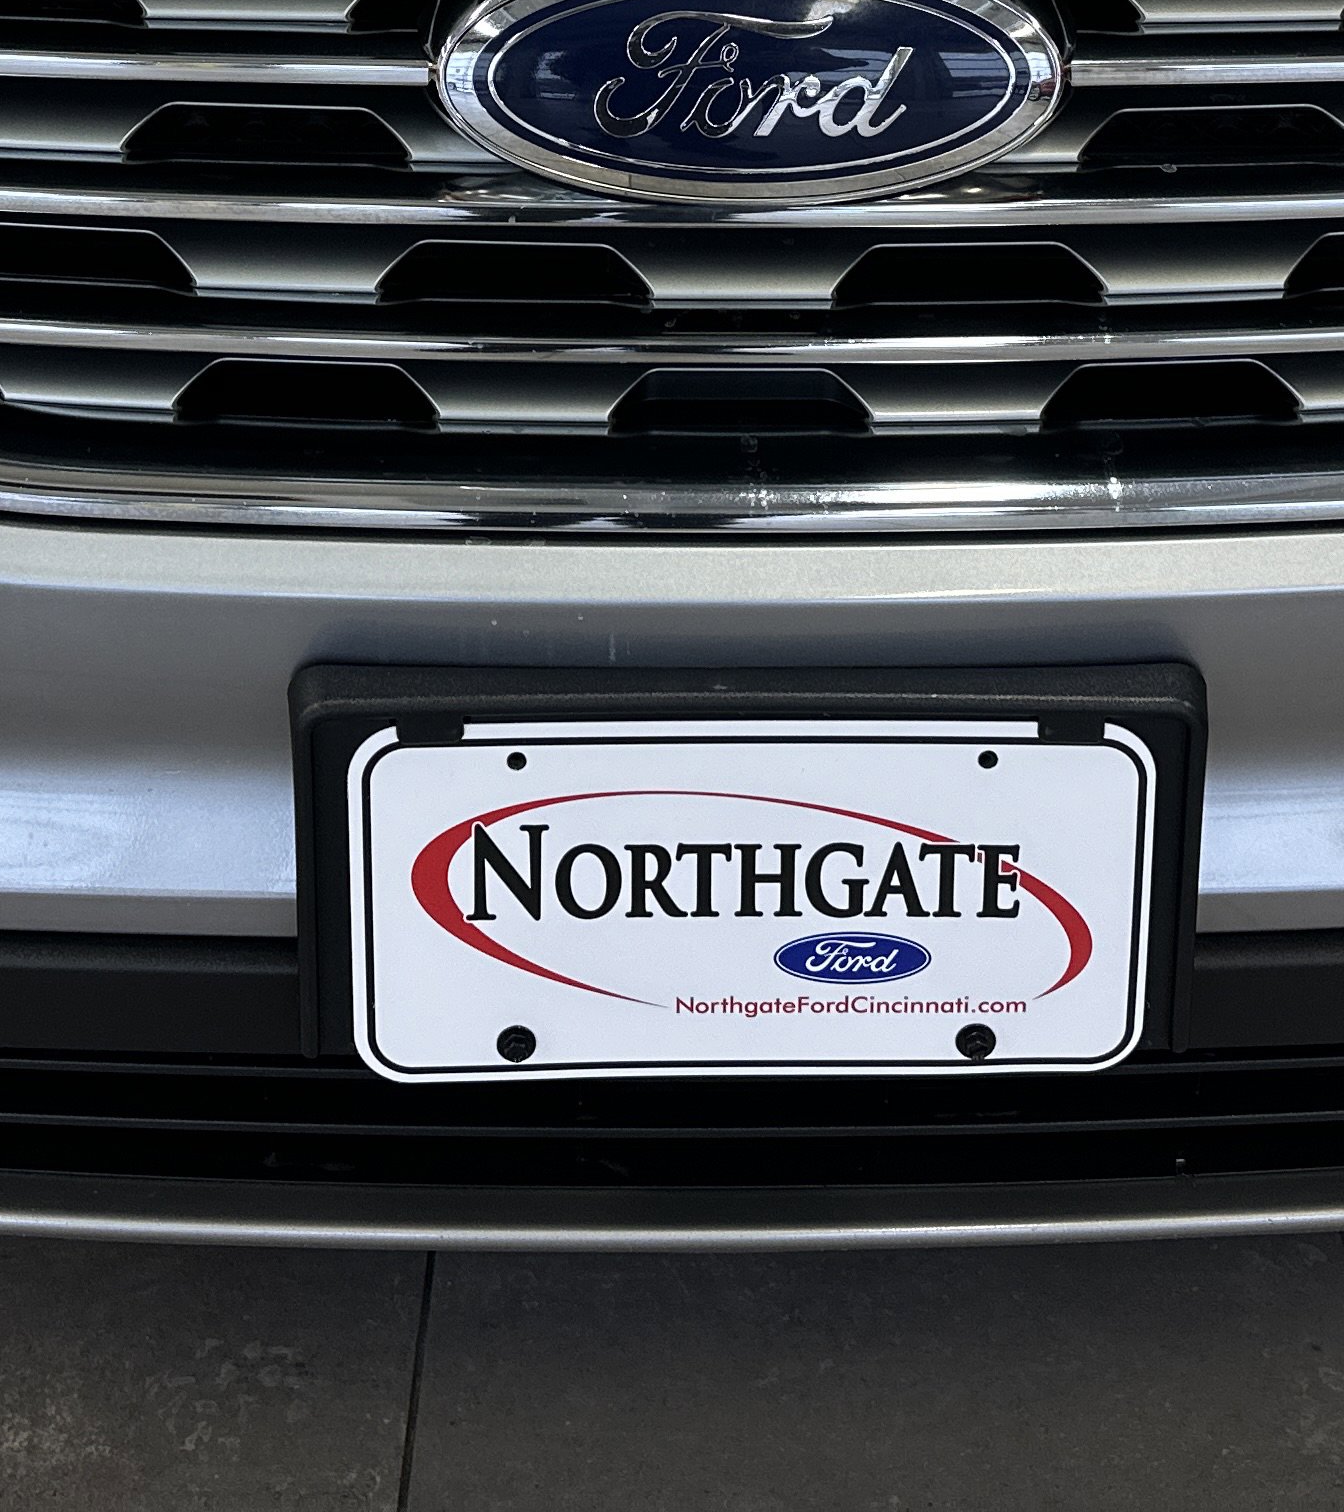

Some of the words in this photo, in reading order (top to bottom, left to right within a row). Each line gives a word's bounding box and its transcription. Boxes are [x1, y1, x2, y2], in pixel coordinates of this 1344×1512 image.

[593, 10, 913, 138] Ford
[805, 939, 896, 974] Ford
[675, 996, 1027, 1018] NorthgateFordCincinnati.com
